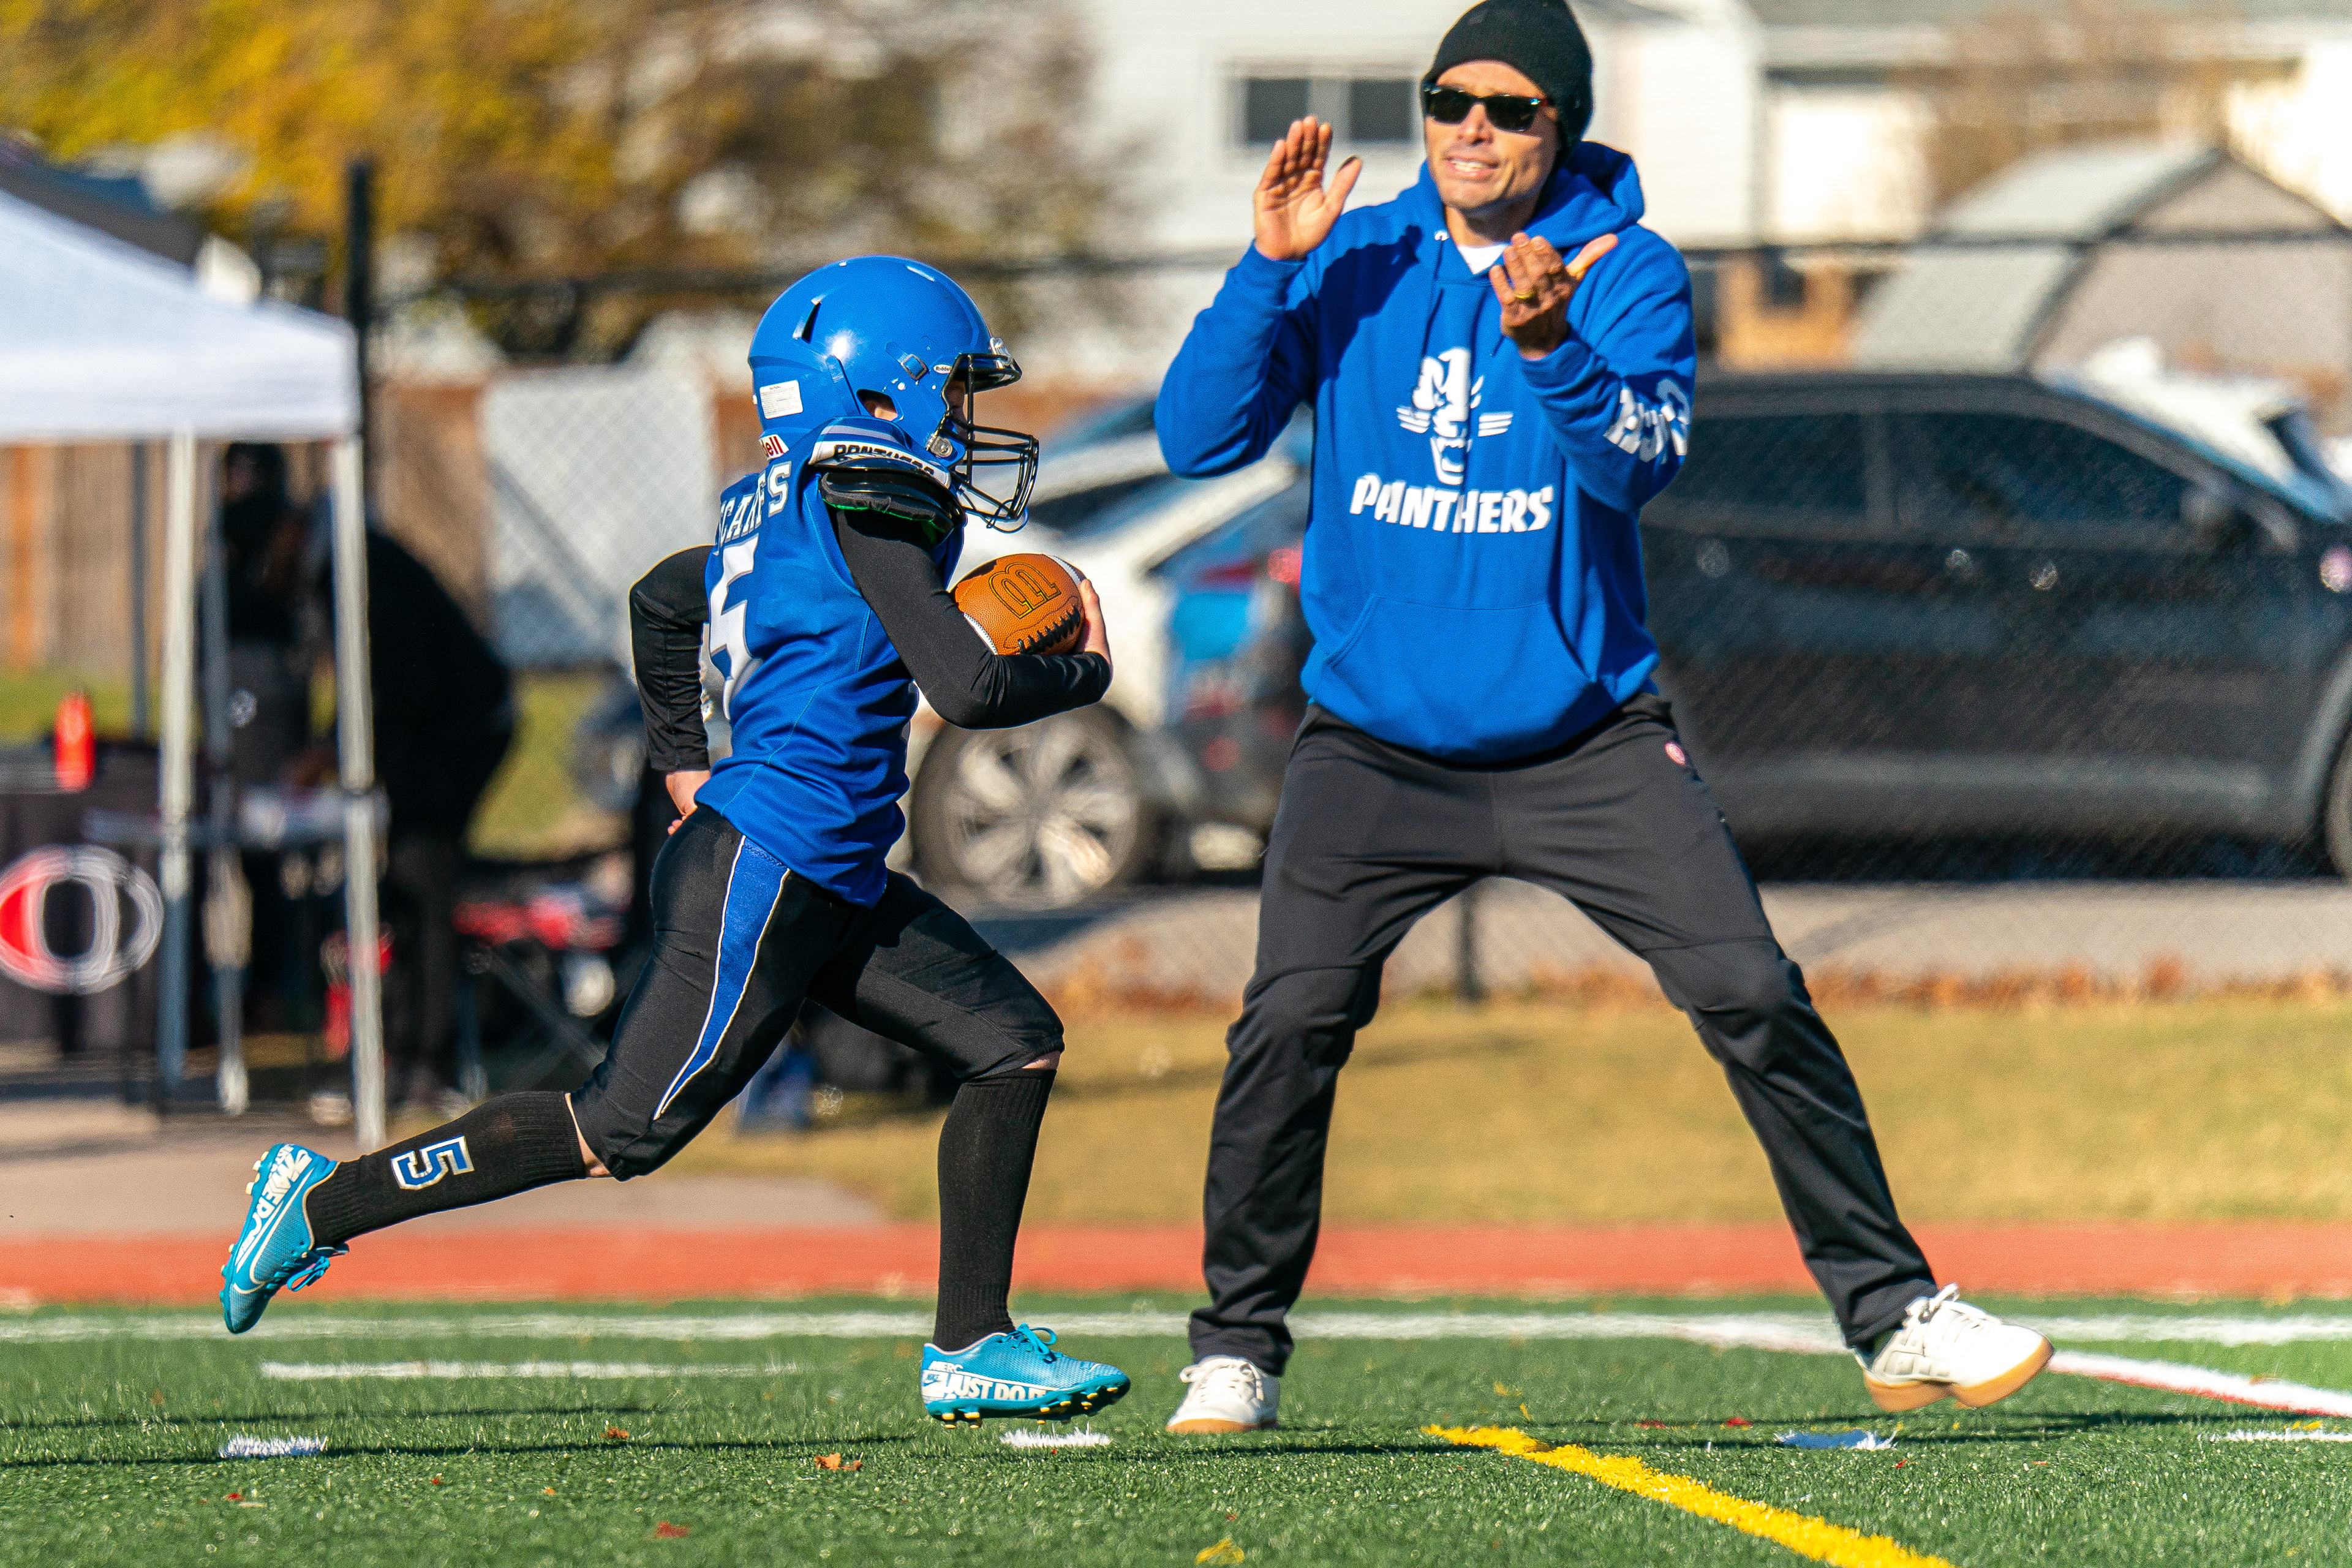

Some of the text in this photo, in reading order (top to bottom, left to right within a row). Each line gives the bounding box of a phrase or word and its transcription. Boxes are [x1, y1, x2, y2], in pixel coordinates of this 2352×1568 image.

[760, 435, 785, 457] ell
[1349, 472, 1554, 533] PANTHERS
[391, 1135, 475, 1191] 5
[927, 1360, 964, 1374] MERC
[944, 1373, 994, 1400] JUST
